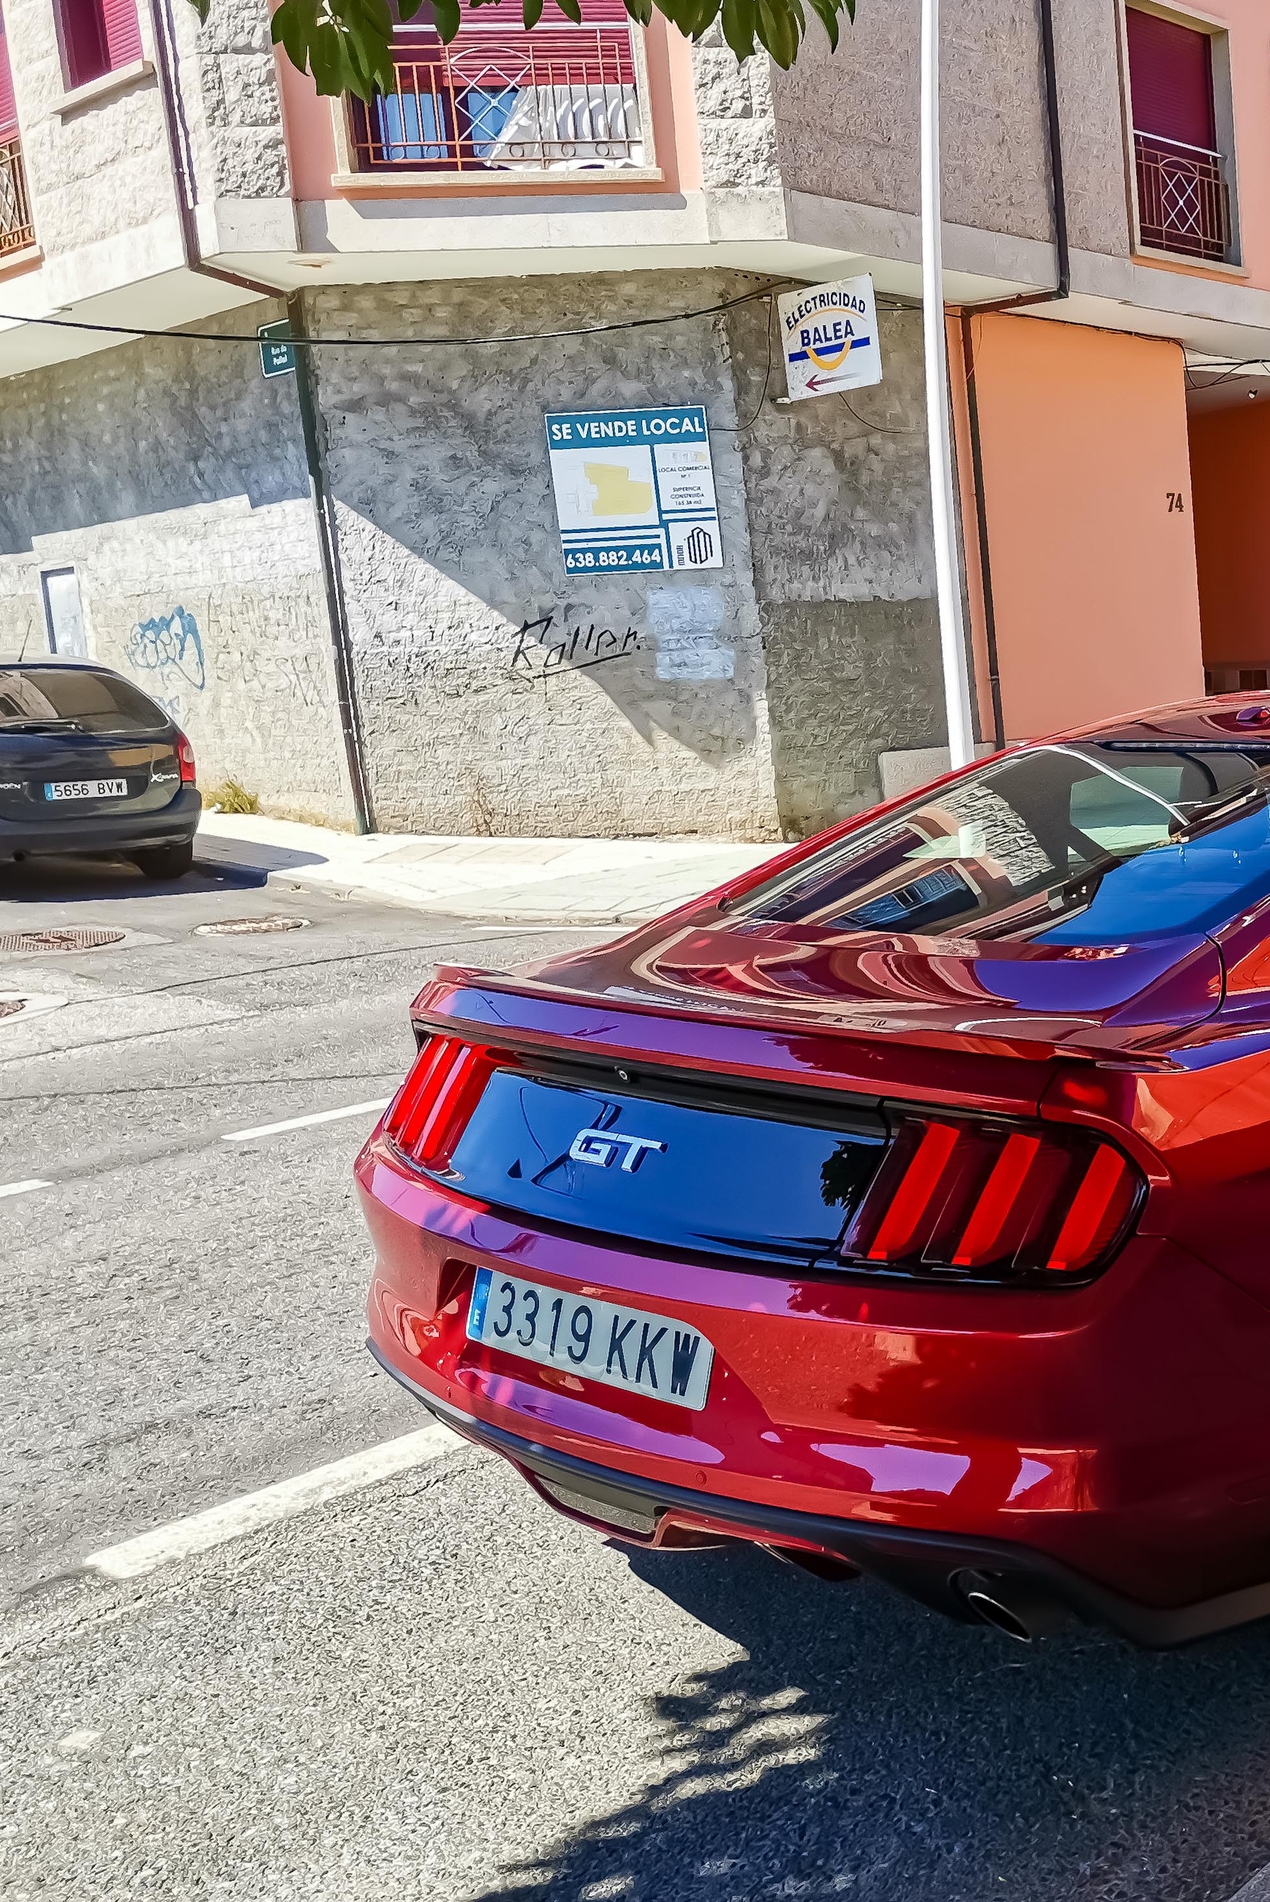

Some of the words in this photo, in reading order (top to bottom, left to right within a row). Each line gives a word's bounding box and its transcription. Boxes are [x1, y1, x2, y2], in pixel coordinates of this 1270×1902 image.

[785, 291, 866, 331] ELECTRICIDAD
[800, 319, 855, 347] BALEA
[551, 424, 573, 441] SE
[575, 420, 638, 439] VENDE
[641, 416, 704, 436] LOCAL
[1166, 492, 1184, 512] 74
[566, 549, 662, 568] 638.882.464
[54, 784, 90, 797] 5656
[97, 780, 123, 794] BVW
[569, 1128, 663, 1173] GT
[493, 1281, 594, 1365] 3319
[606, 1313, 701, 1397] KKW
